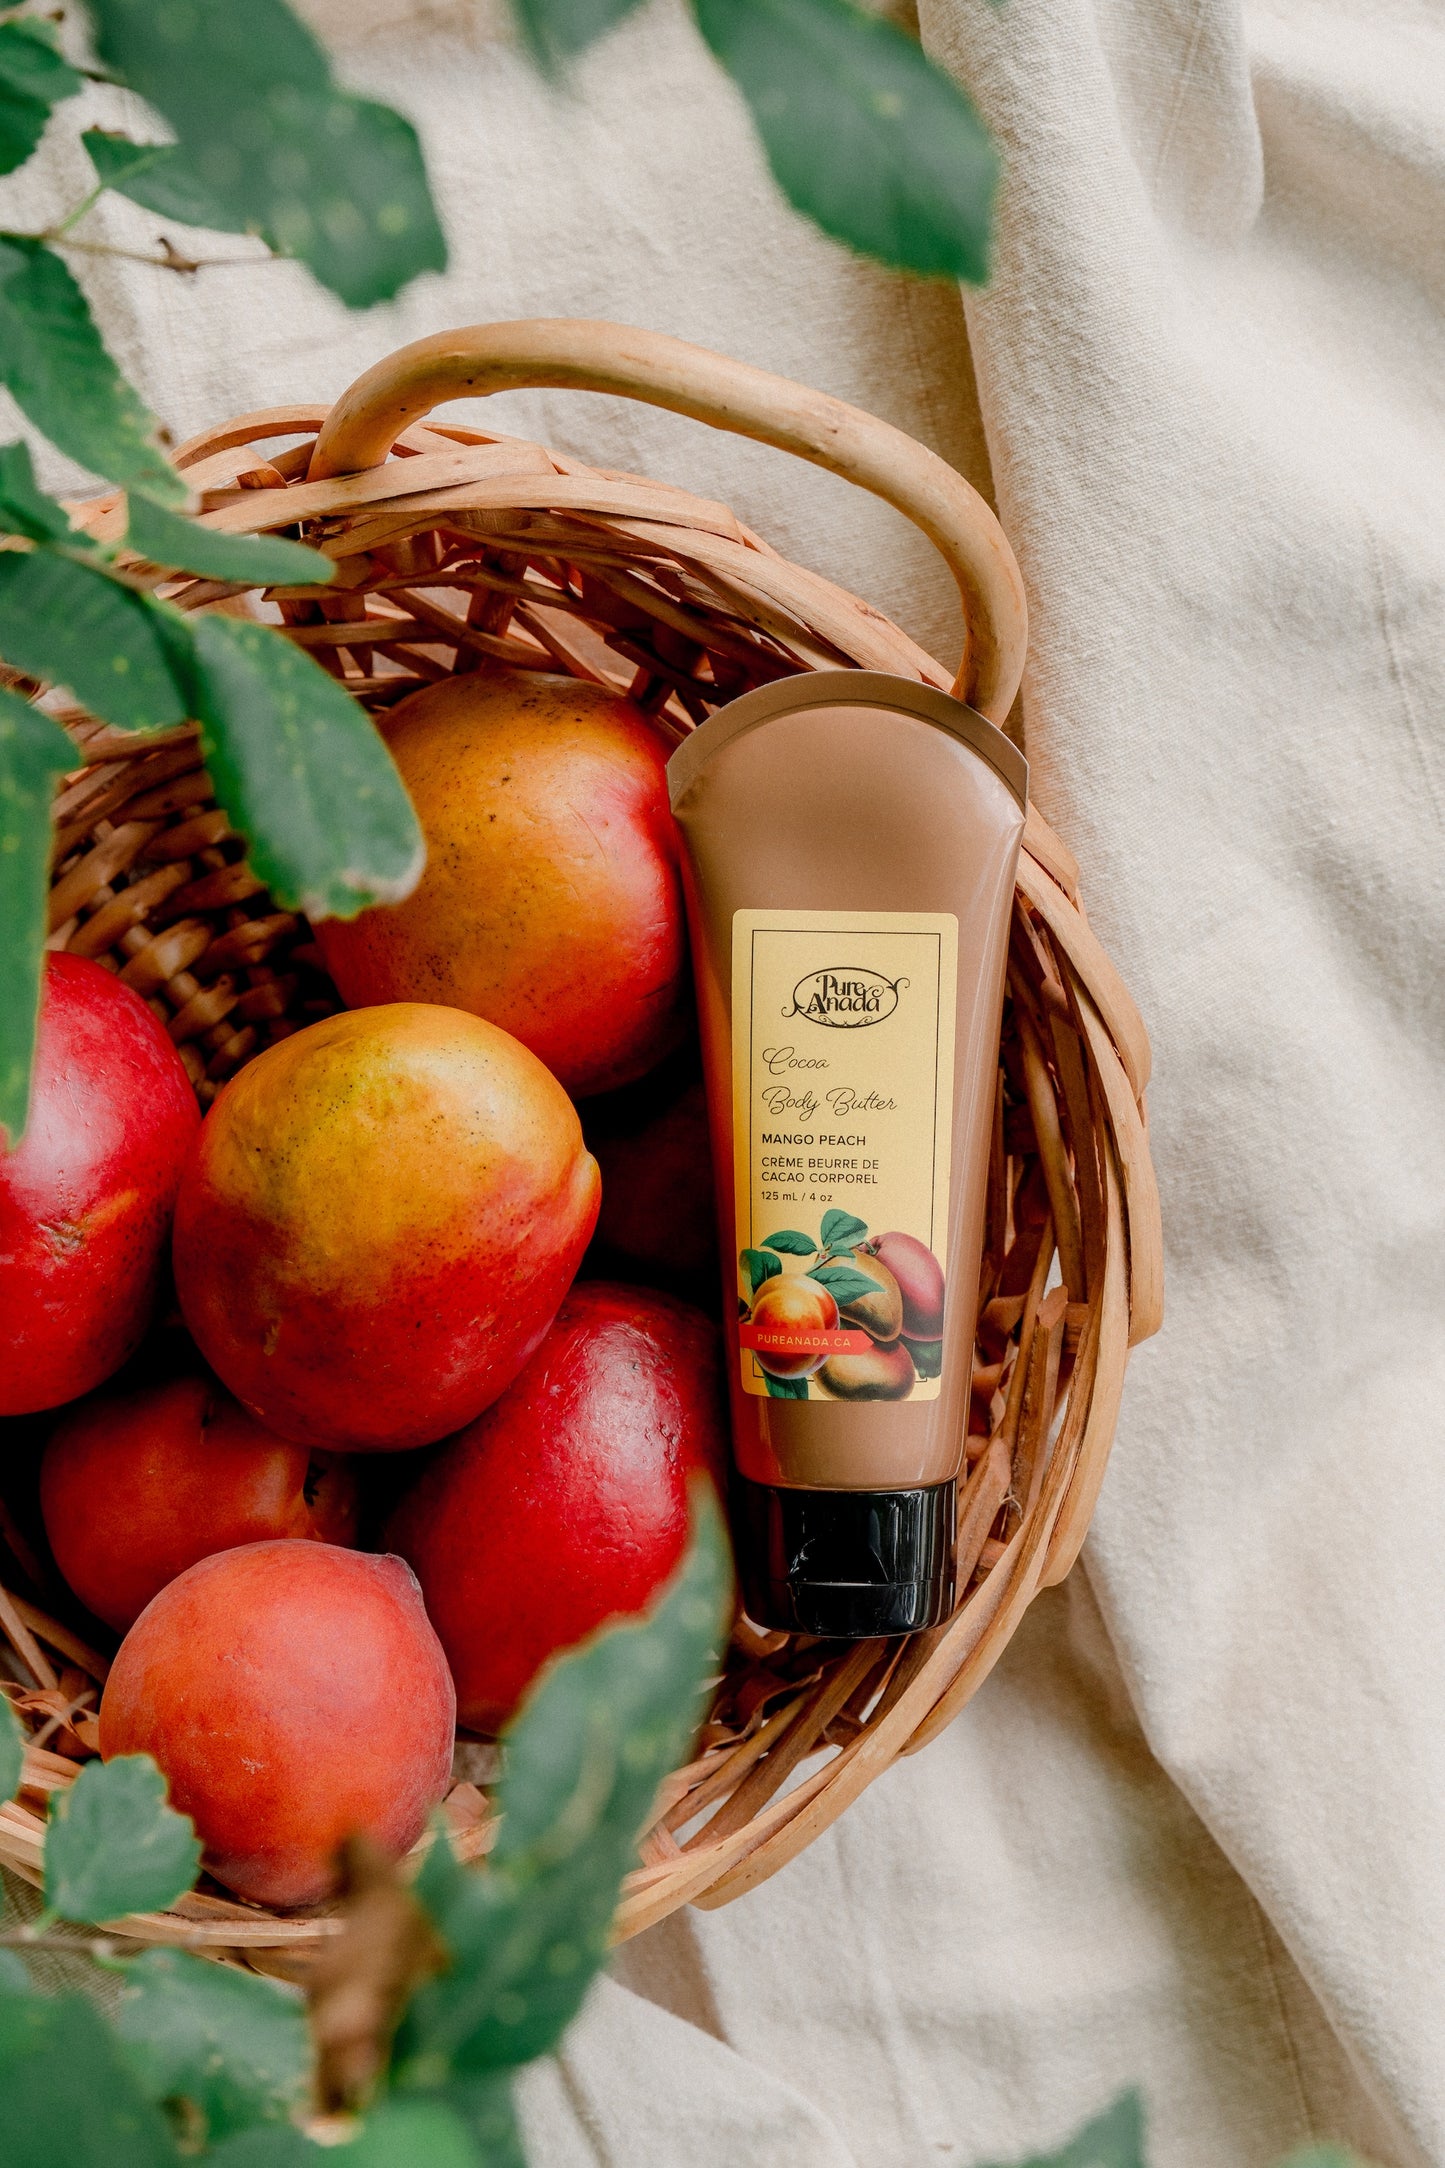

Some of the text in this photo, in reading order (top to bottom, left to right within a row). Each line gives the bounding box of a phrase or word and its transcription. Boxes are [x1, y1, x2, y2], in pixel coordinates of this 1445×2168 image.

[816, 974, 873, 1000] Pure
[804, 991, 880, 1014] Anada
[761, 1046, 830, 1075] Cocoa
[761, 1085, 898, 1122] Body Butter
[761, 1133, 866, 1147] MANGO PEACH
[761, 1155, 880, 1170] CRÈME BEURRE DE
[761, 1172, 879, 1185] CACAO CORPOREL
[761, 1191, 833, 1203] 125 mL / 4 oz
[757, 1333, 851, 1347] PUREANADA.CA
